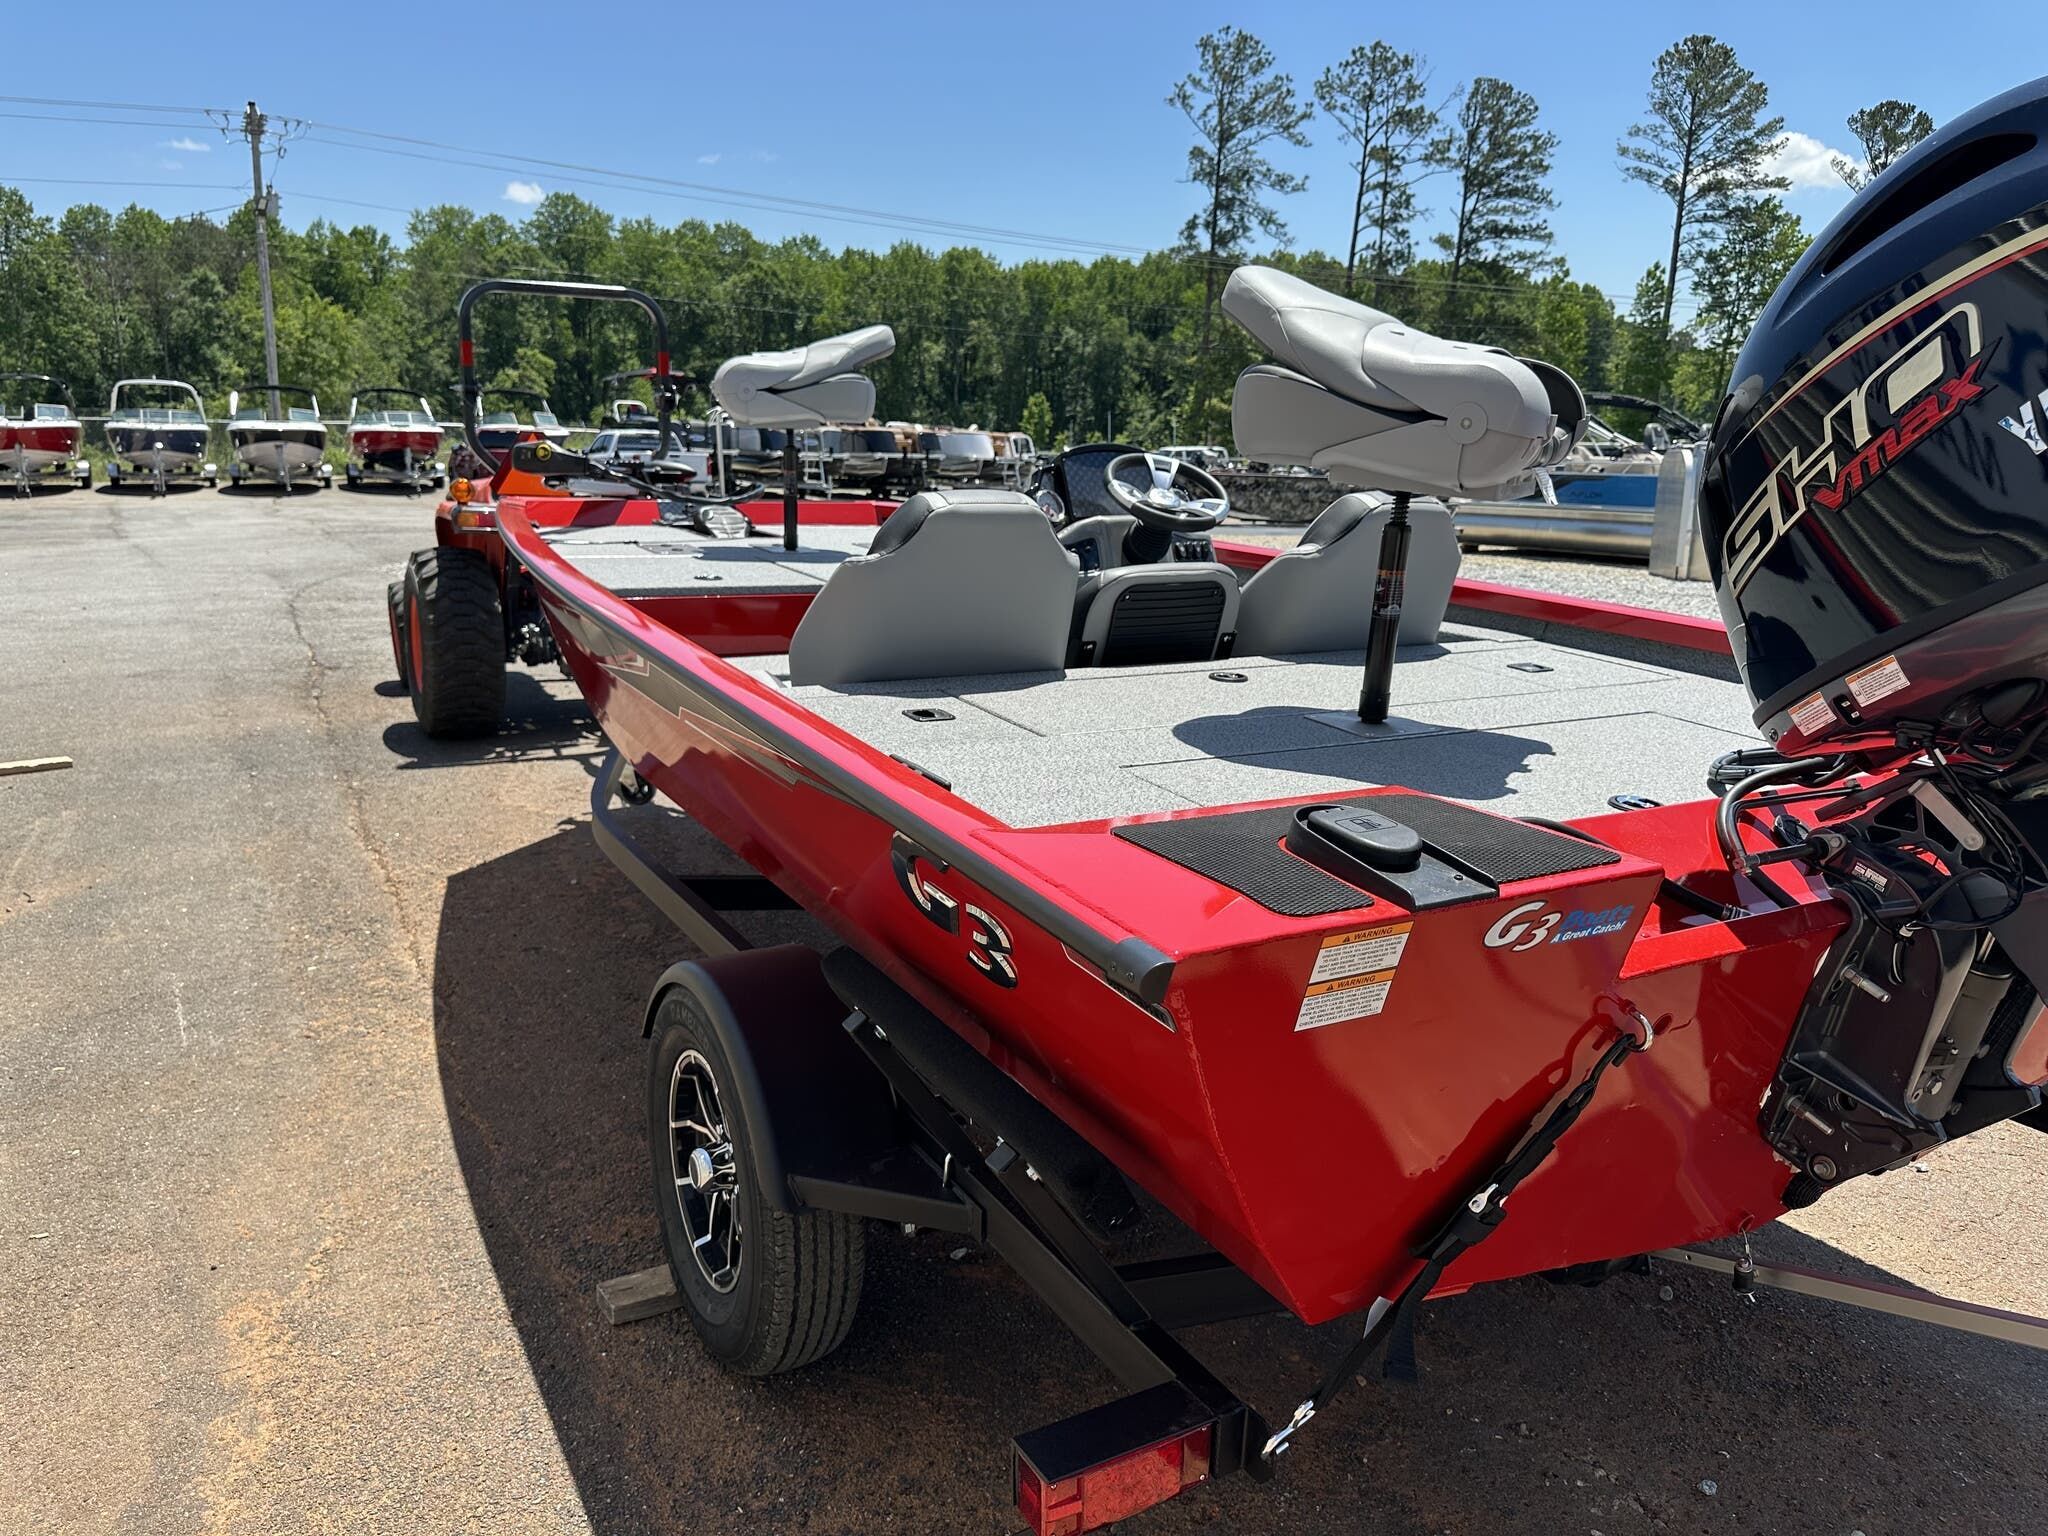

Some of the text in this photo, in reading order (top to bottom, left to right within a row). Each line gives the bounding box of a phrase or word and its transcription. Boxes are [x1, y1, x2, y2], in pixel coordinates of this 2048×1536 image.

[1354, 927, 1392, 939] WARNING
[1483, 900, 1634, 951] G3 Boats
[1561, 927, 1591, 941] Great
[1592, 920, 1628, 935] Catch!
[1338, 976, 1375, 988] WARNING
